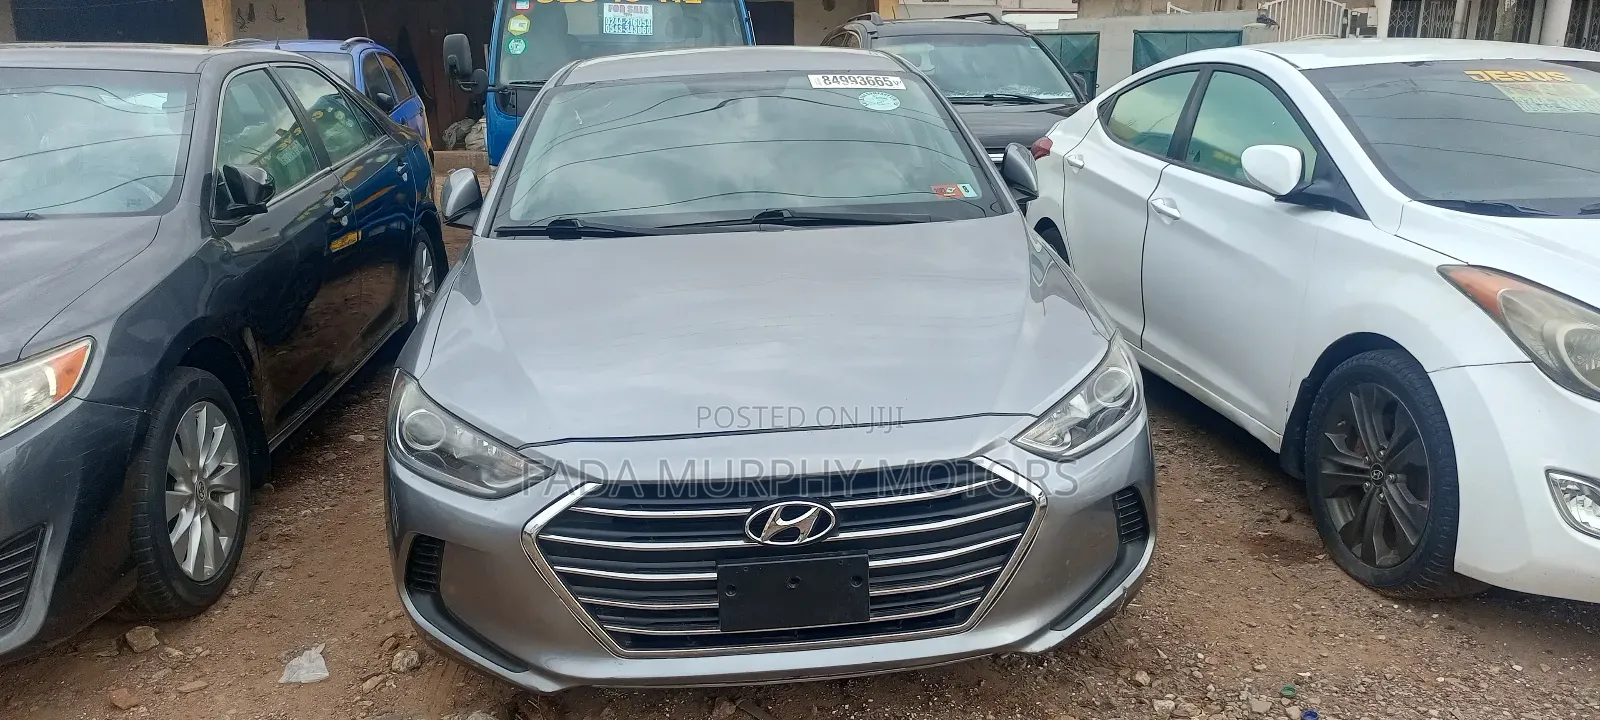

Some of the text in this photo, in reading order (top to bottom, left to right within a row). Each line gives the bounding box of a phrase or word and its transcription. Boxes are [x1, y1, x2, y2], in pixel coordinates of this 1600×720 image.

[607, 4, 650, 14] FOR SALE
[821, 75, 894, 87] 84993665
[1464, 69, 1573, 83] JESUS
